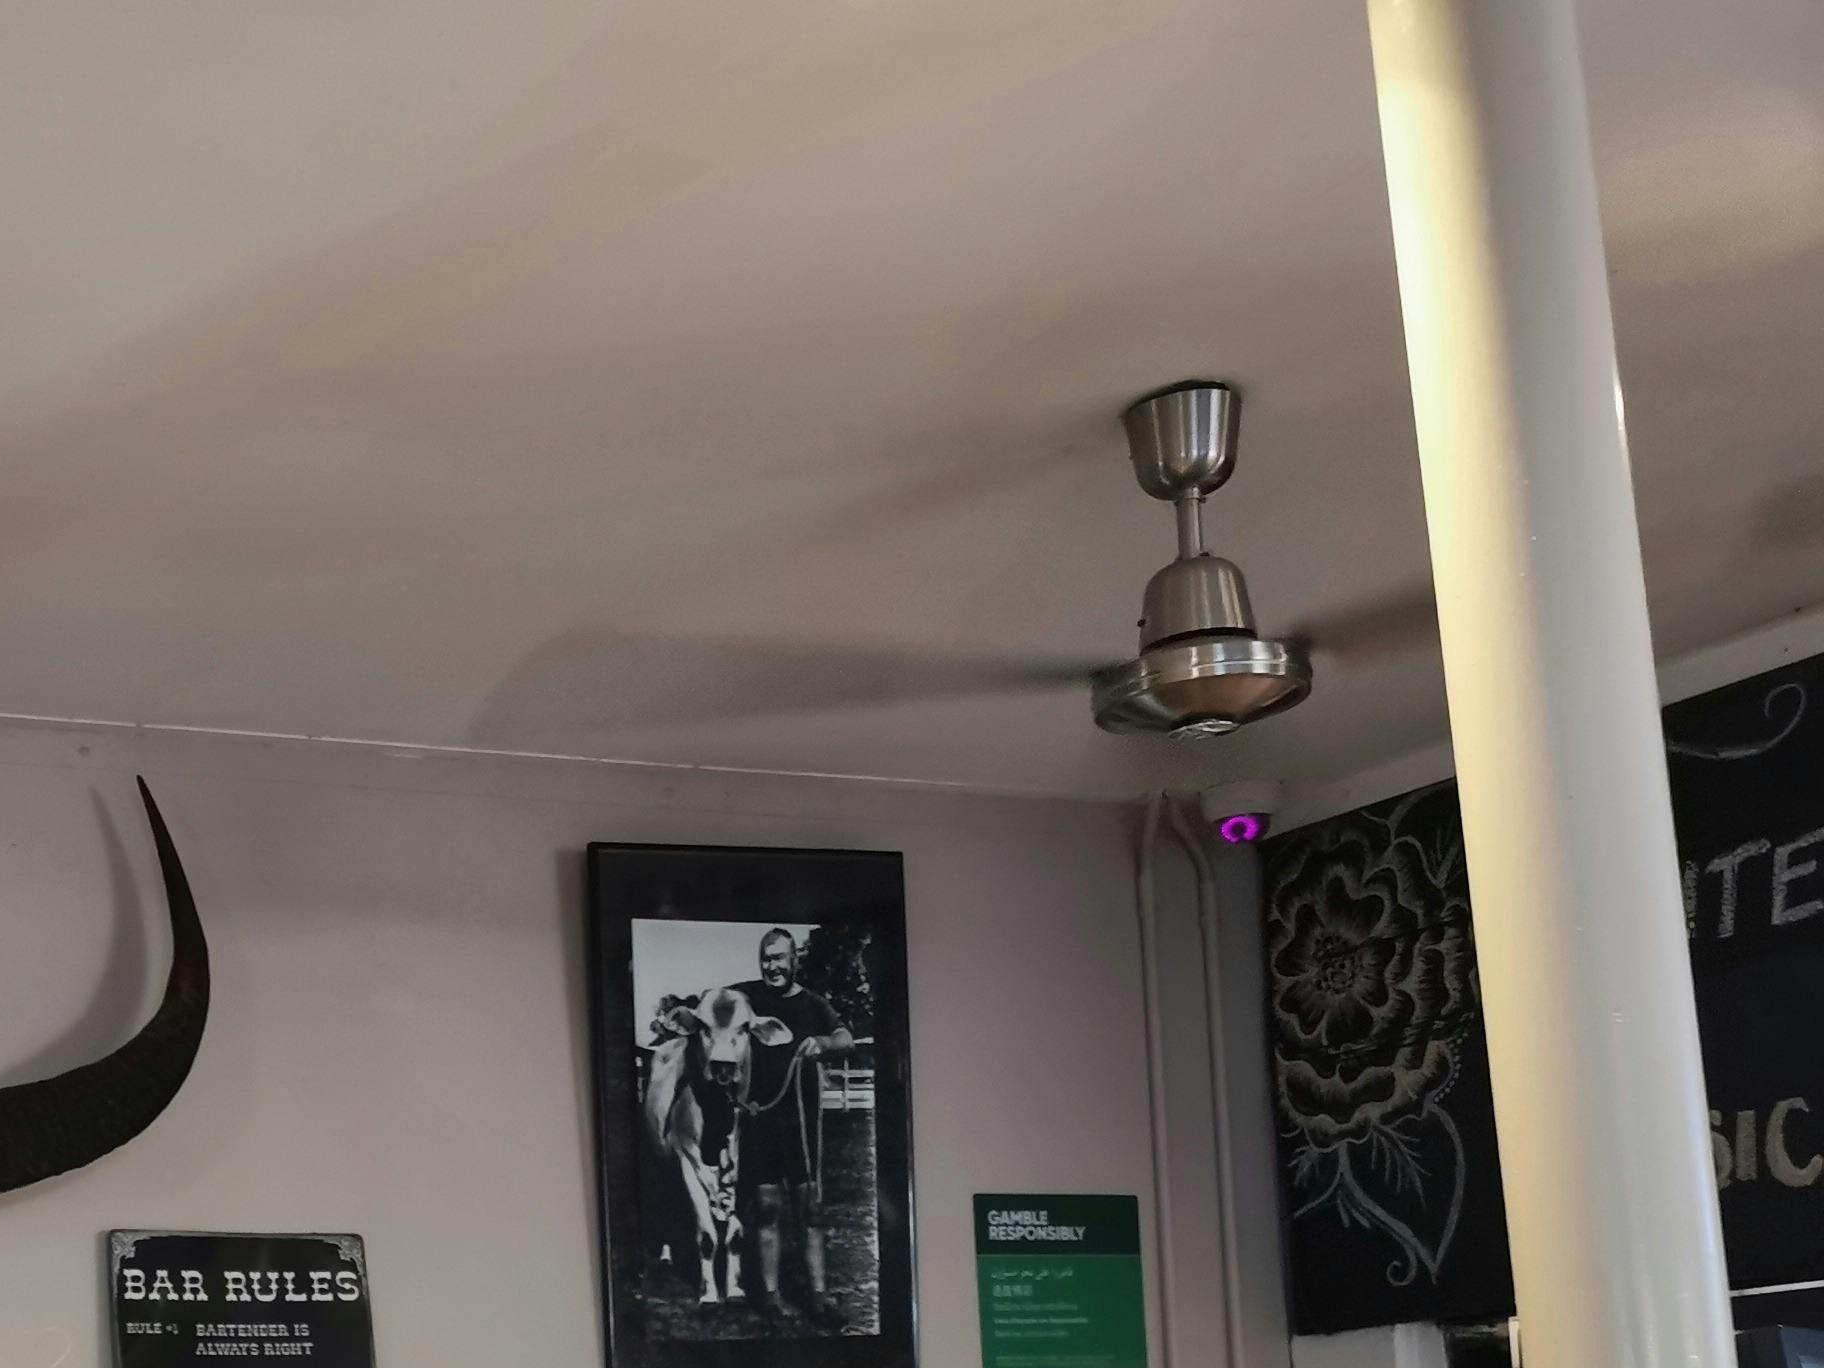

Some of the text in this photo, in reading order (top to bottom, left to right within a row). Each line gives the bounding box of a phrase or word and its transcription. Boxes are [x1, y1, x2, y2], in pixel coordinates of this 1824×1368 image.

[987, 1210, 1048, 1225] GAMBLE
[988, 1226, 1086, 1240] RESPONSIBLY
[122, 1268, 360, 1302] BAR RULES
[126, 1322, 162, 1334] RULE
[195, 1323, 290, 1337] BARTENDER
[293, 1324, 310, 1336] IS
[195, 1342, 314, 1356] ALWAYS RIGHT
